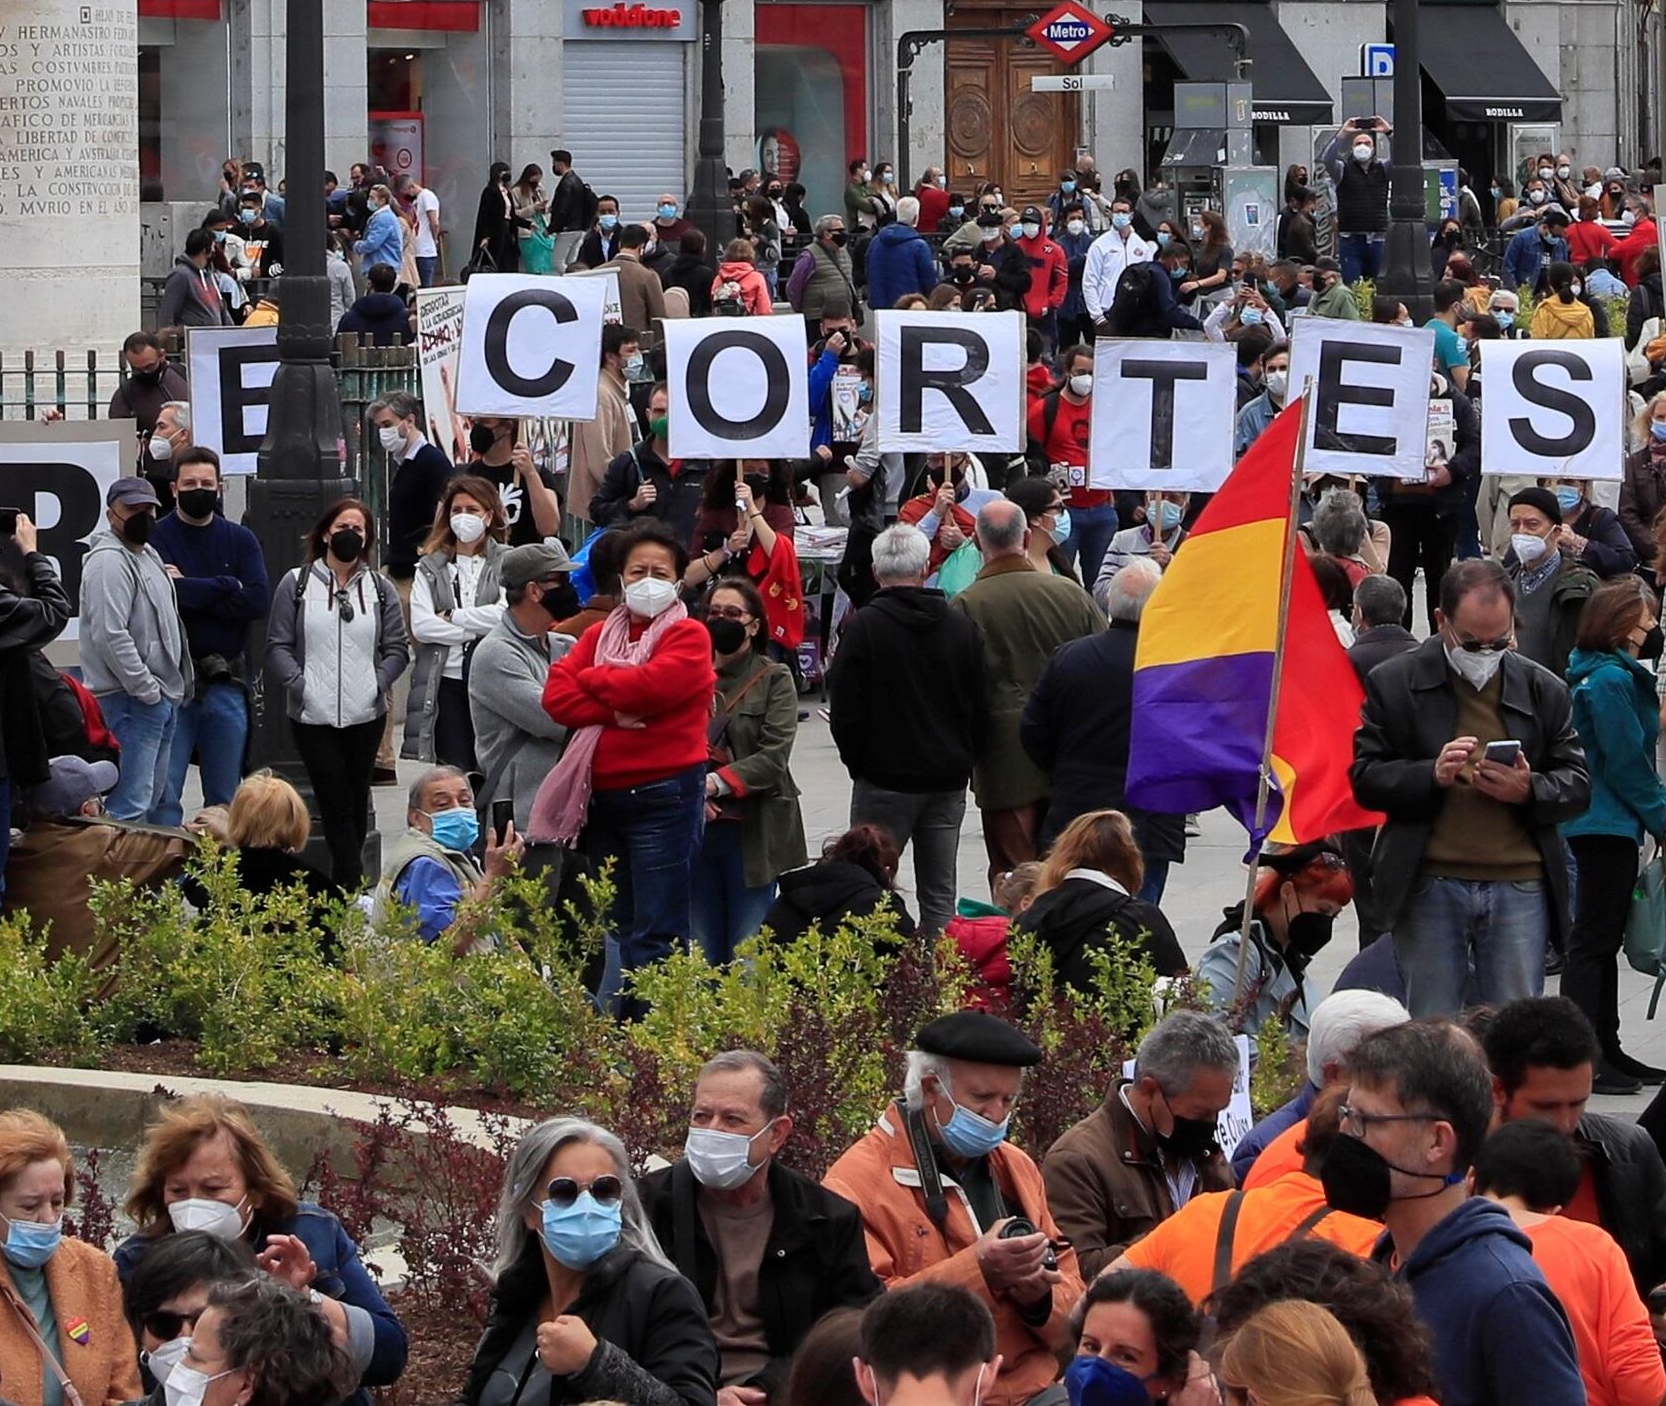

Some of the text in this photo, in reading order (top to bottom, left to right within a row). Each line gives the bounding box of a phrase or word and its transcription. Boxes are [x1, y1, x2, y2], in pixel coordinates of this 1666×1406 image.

[581, 1, 682, 29] vodafone
[17, 25, 111, 41] HERMANASTRO
[1050, 24, 1086, 38] Metro
[52, 42, 105, 57] ARTISTAS
[1062, 77, 1083, 90] Sol
[1485, 106, 1524, 118] RODILLA
[16, 130, 79, 145] LIBERTAD
[20, 200, 72, 215] MVRIO
[484, 288, 579, 398] C
[684, 329, 792, 439] O
[898, 326, 998, 435] R
[1311, 336, 1401, 458] E
[1506, 349, 1597, 459] S
[1120, 359, 1209, 470] T
